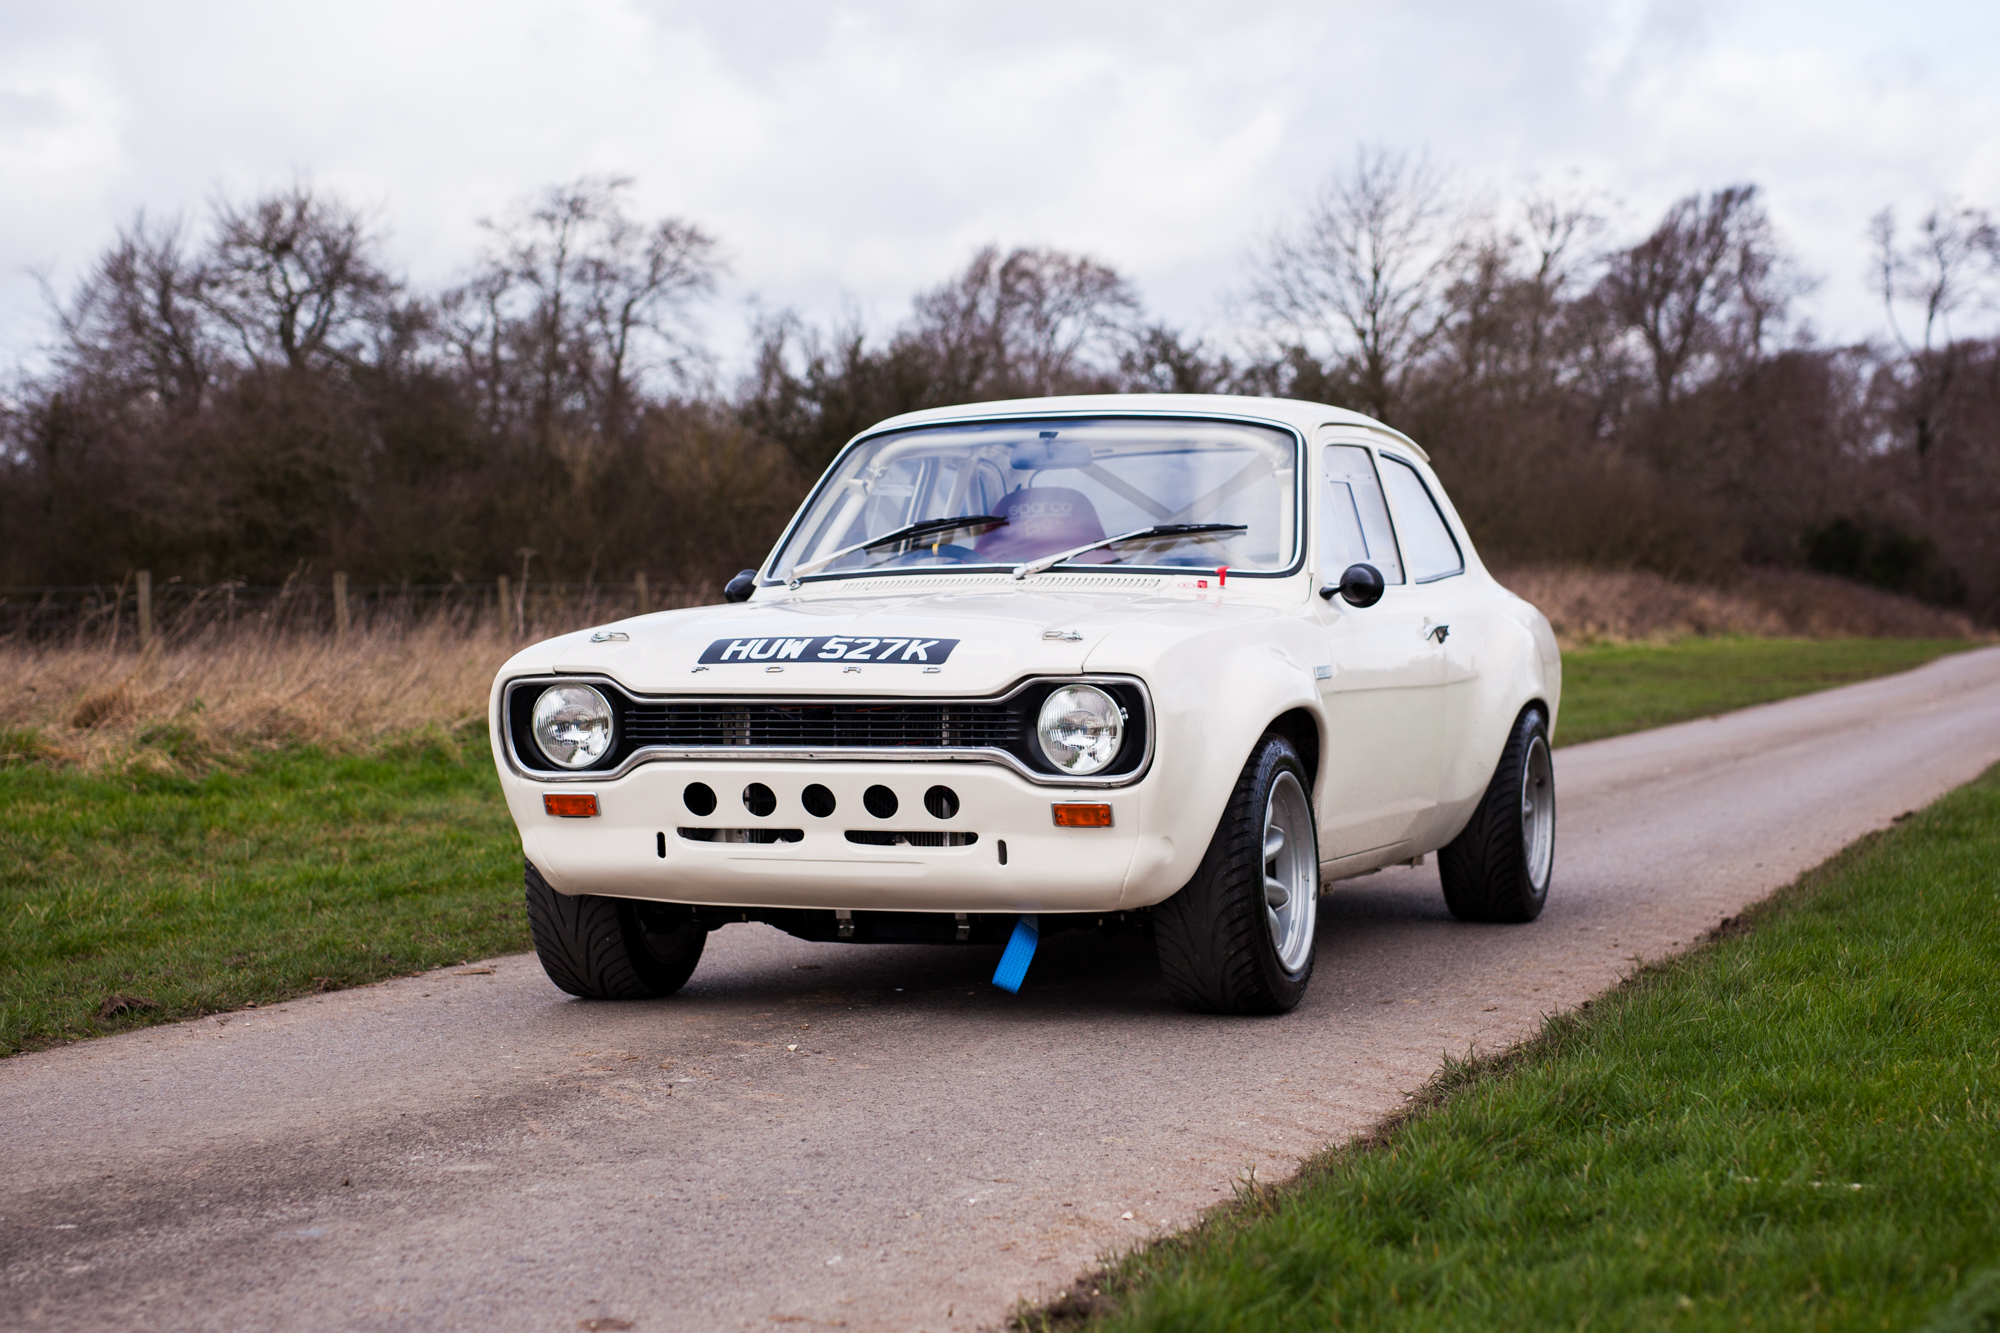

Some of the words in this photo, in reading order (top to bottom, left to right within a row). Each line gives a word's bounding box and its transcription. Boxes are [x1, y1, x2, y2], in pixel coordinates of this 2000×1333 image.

[1008, 501, 1073, 518] sparco
[720, 638, 814, 660] HUW
[817, 637, 940, 661] 527K
